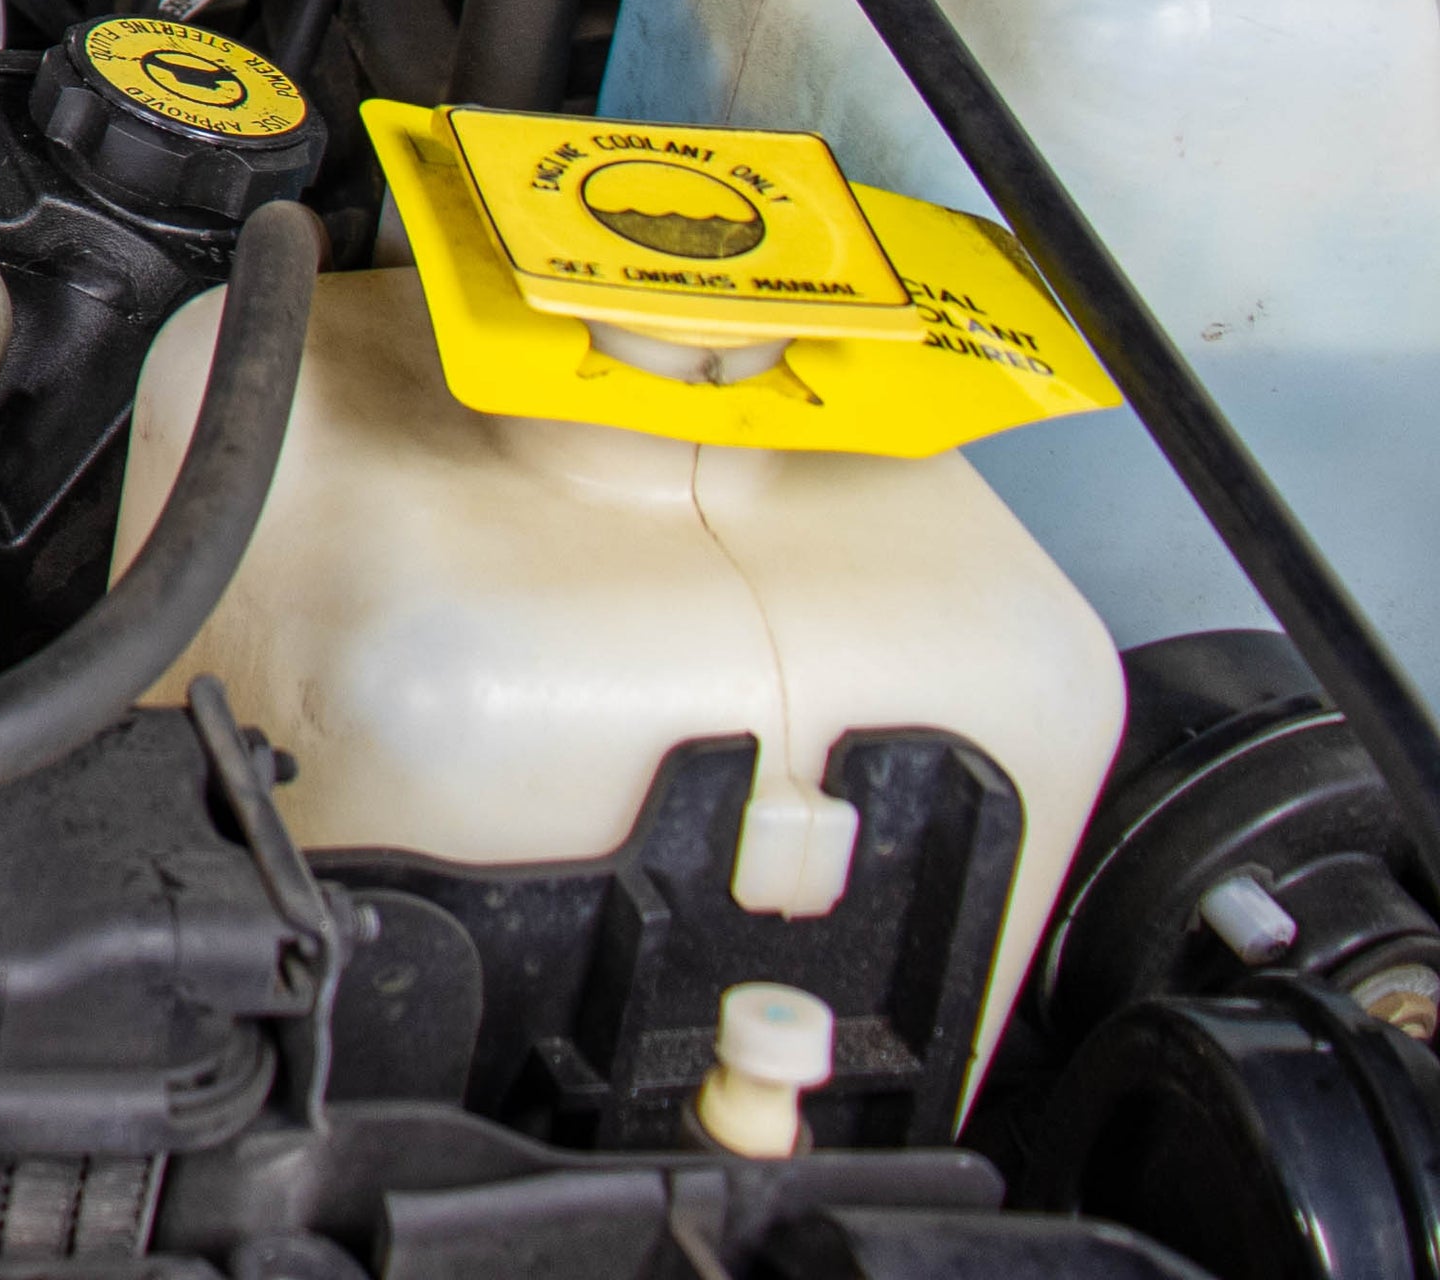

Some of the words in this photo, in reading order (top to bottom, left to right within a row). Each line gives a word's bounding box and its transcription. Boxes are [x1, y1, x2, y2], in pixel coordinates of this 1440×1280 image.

[90, 28, 122, 63] FLUID
[119, 19, 236, 54] STEERING
[244, 56, 299, 100] POWER
[125, 86, 243, 133] APPROVED
[251, 113, 292, 133] USE
[532, 143, 588, 192] ENGINE
[591, 134, 717, 163] COOLANT
[729, 164, 792, 205] ONLY
[548, 257, 601, 278] SEE
[751, 276, 860, 297] MANUAL
[901, 276, 987, 317] CIAL
[915, 302, 1039, 352] OLANT
[922, 329, 1055, 377] QUIRED
